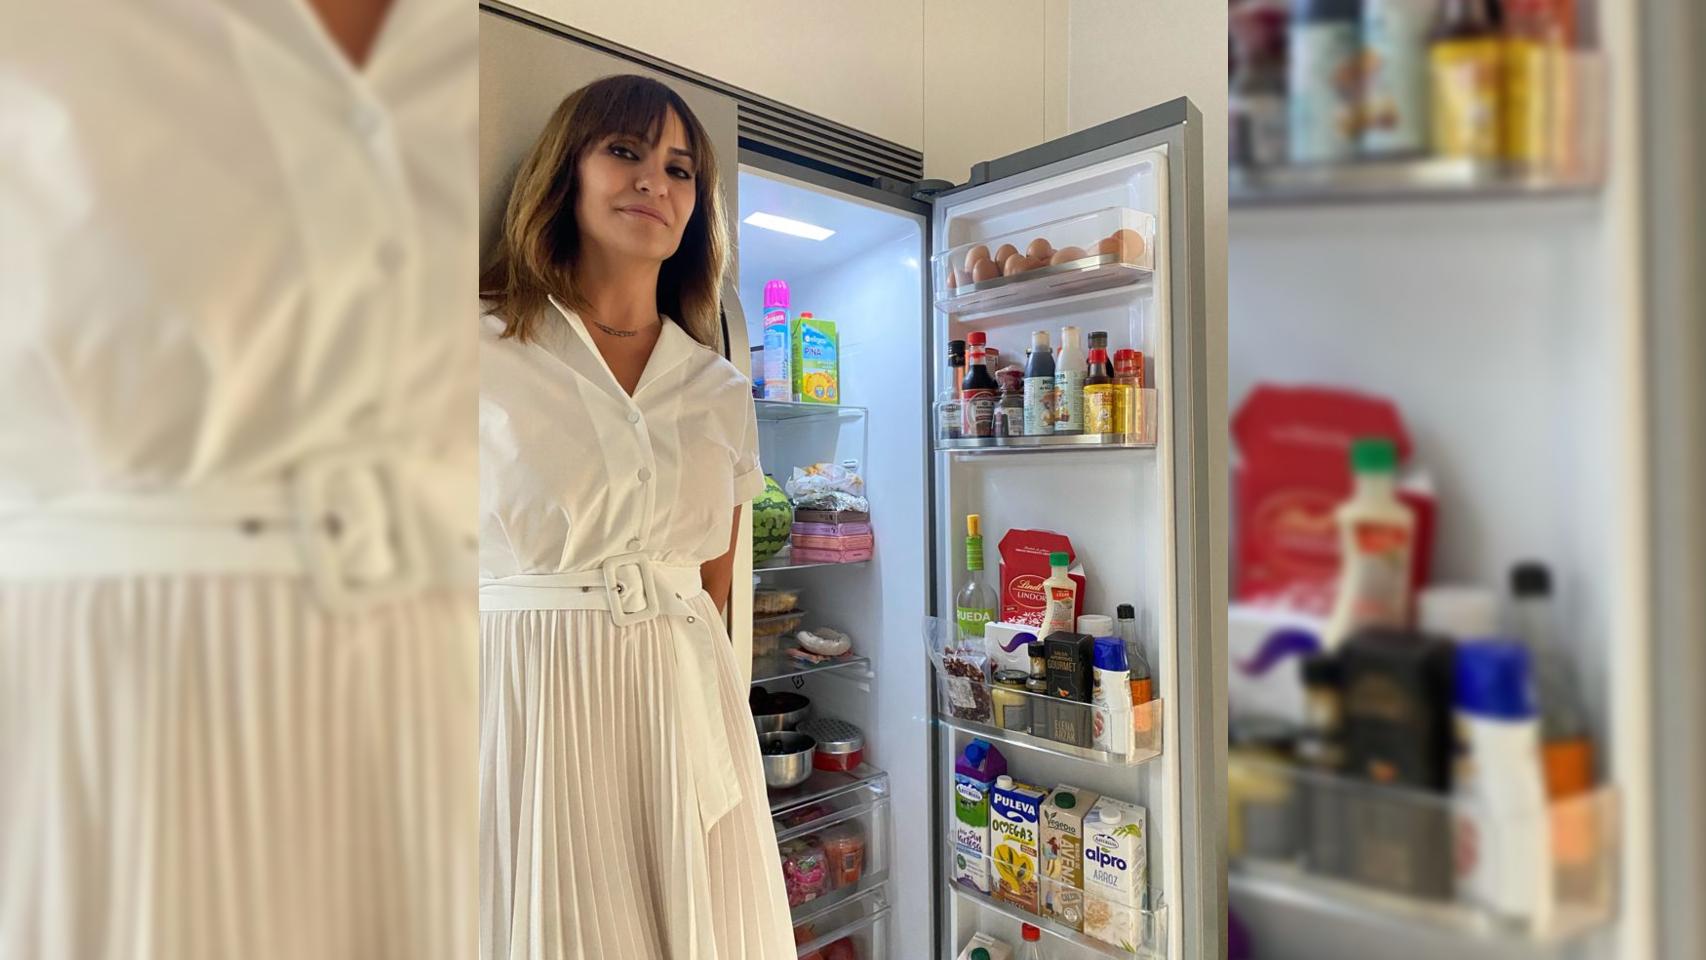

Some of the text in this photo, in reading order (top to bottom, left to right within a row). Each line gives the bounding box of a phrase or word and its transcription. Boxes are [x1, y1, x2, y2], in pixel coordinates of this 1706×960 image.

[993, 792, 1036, 816] PULEVA
[1061, 840, 1076, 887] AVENA
[1085, 845, 1128, 871] alpro
[1093, 869, 1119, 887] ARROZ
